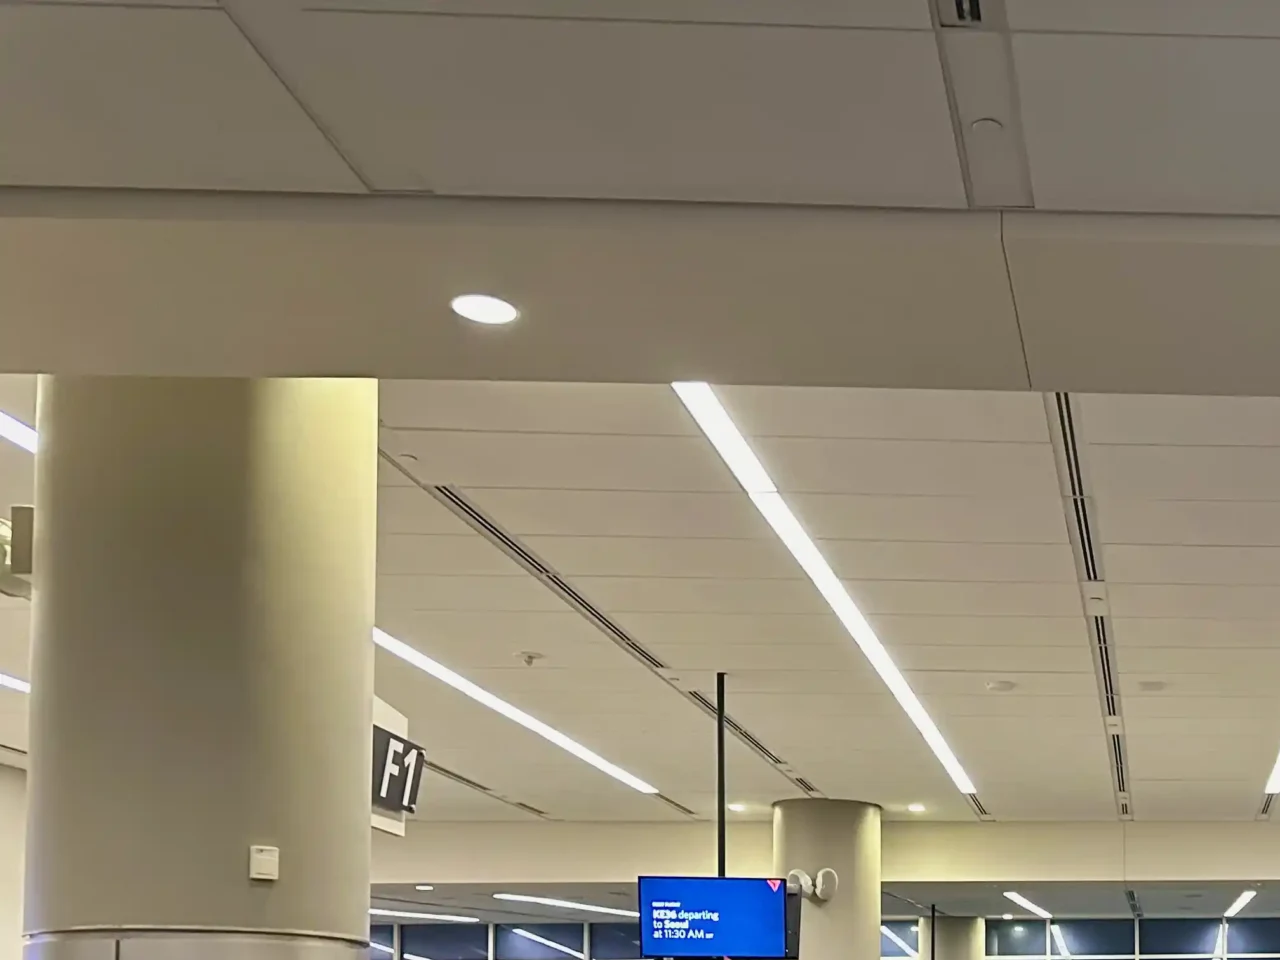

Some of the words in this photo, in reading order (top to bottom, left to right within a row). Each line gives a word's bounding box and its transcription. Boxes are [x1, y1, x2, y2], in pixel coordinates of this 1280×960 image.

[379, 737, 418, 807] F1
[678, 909, 720, 921] departing
[653, 920, 663, 929] to
[663, 920, 689, 929] Seoul
[653, 930, 663, 939] at
[664, 929, 686, 939] 11:30
[687, 929, 705, 939] AM
